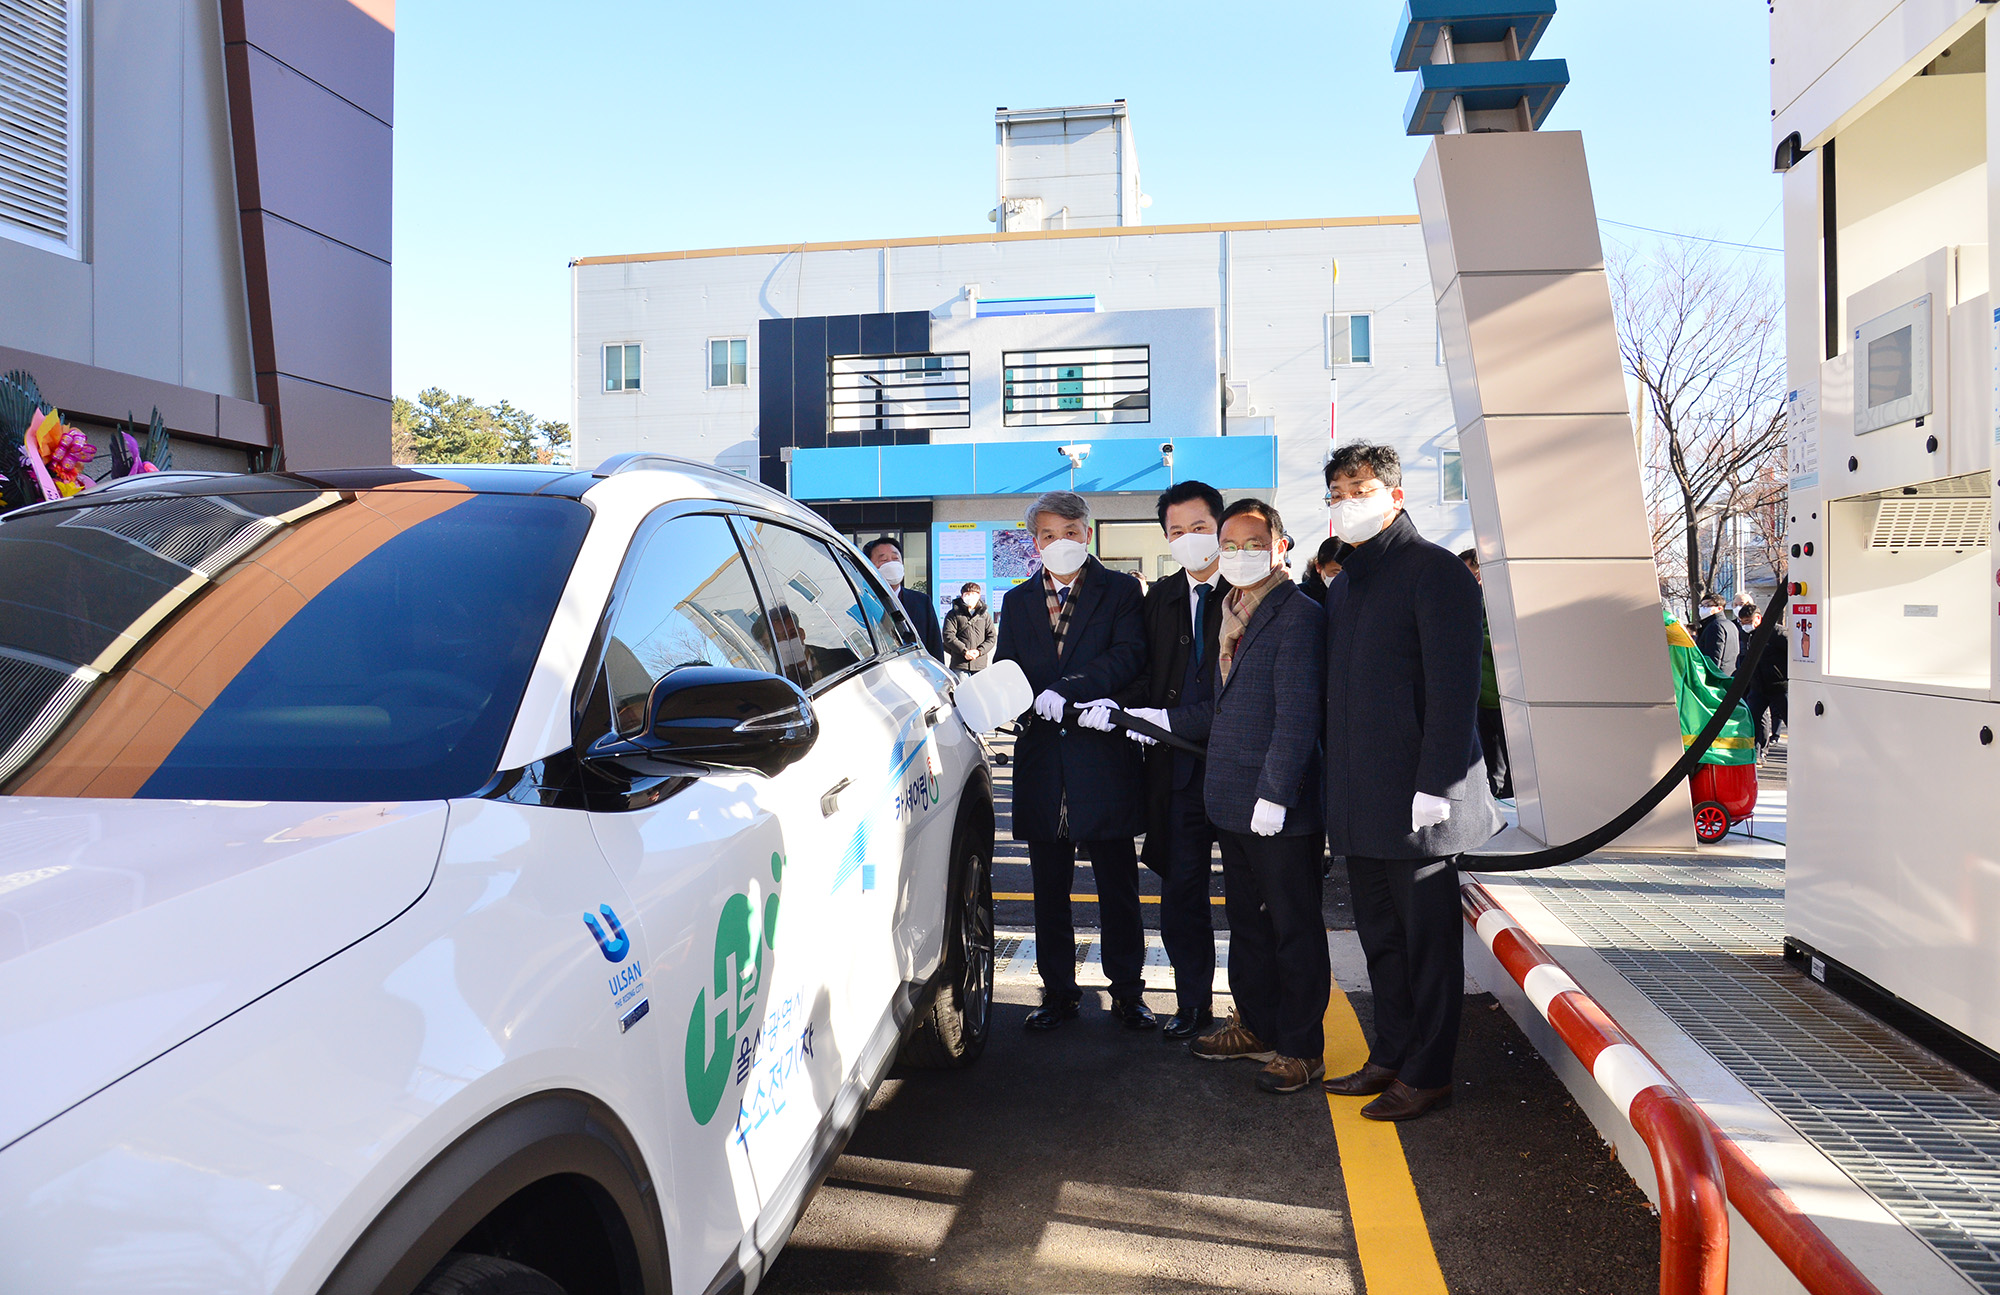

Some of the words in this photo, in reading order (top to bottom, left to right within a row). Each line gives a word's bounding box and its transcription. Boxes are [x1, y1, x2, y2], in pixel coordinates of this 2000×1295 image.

[1855, 390, 1928, 433] EXICOM
[608, 961, 642, 996] ULSAN
[736, 985, 804, 1086] 울산광역시
[736, 1022, 814, 1153] 수소전기차
